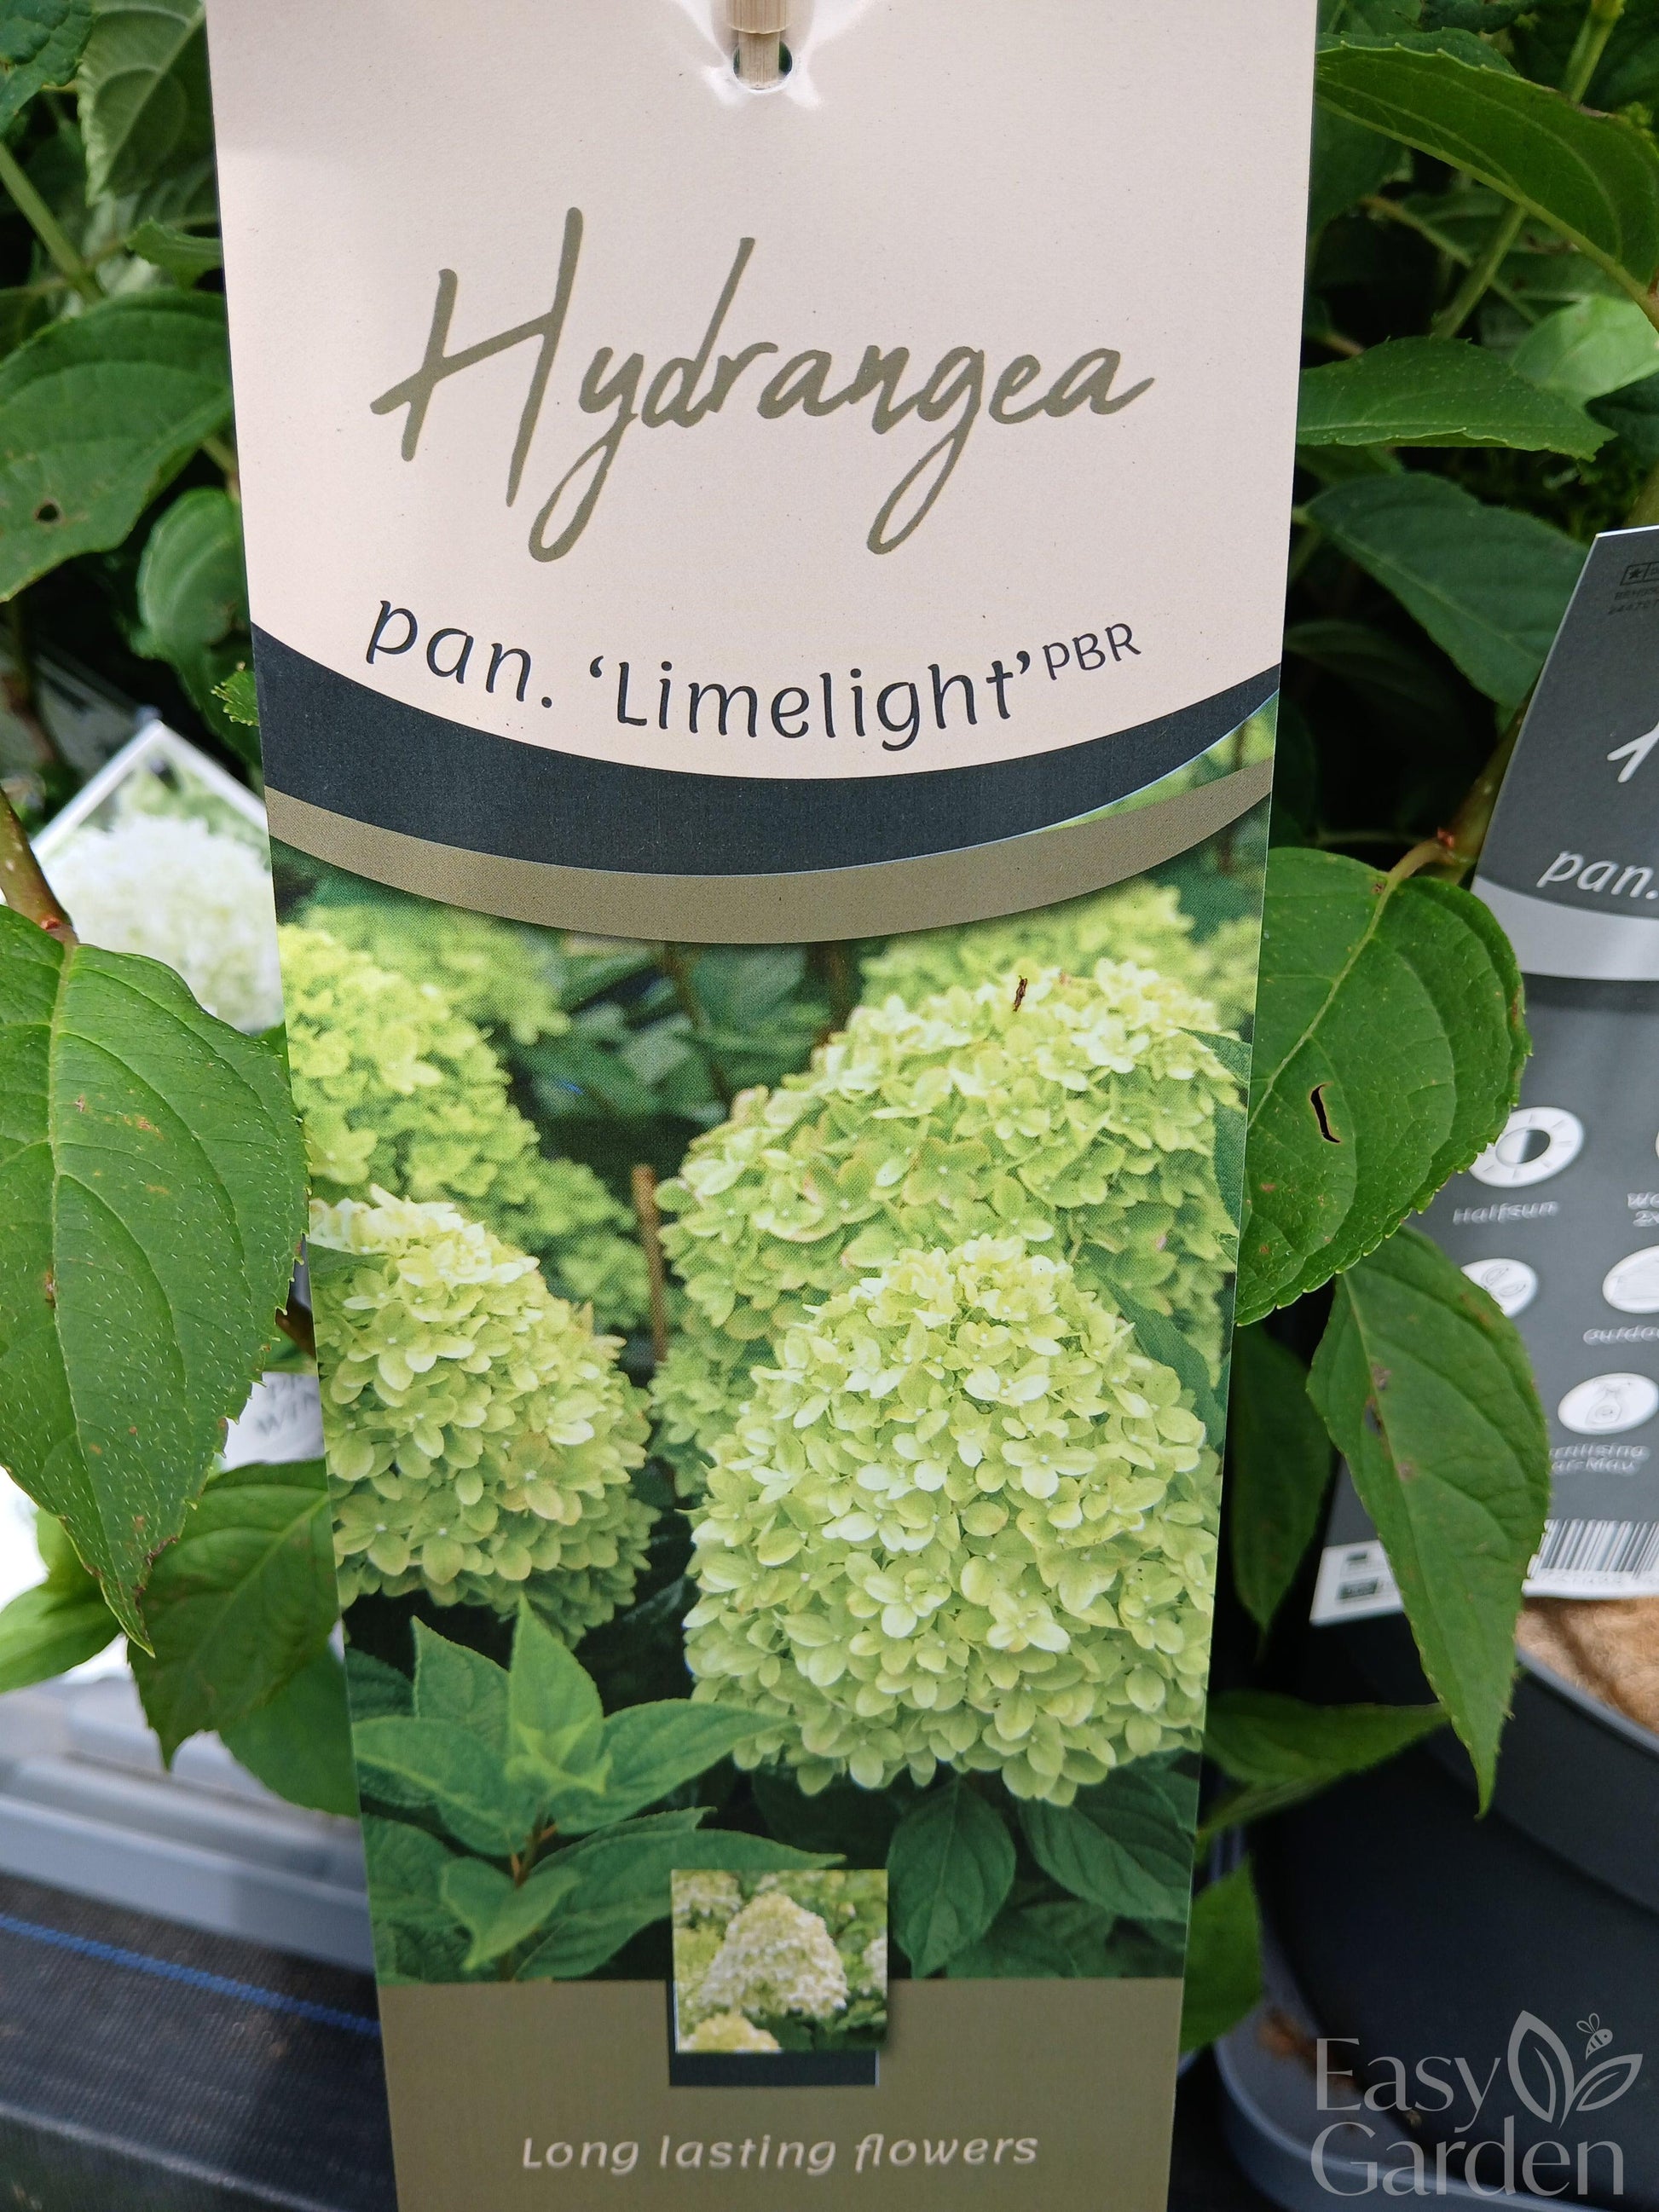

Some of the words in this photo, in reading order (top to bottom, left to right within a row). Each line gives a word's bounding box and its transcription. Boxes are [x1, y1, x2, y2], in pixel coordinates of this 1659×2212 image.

[369, 206, 1156, 563] Hydrangea
[365, 598, 553, 708] pan.
[1042, 621, 1142, 680] PBR
[1535, 850, 1659, 901] pan.
[522, 2135, 639, 2176] Long
[659, 2135, 836, 2177] lasting
[854, 2133, 1038, 2174] flowers
